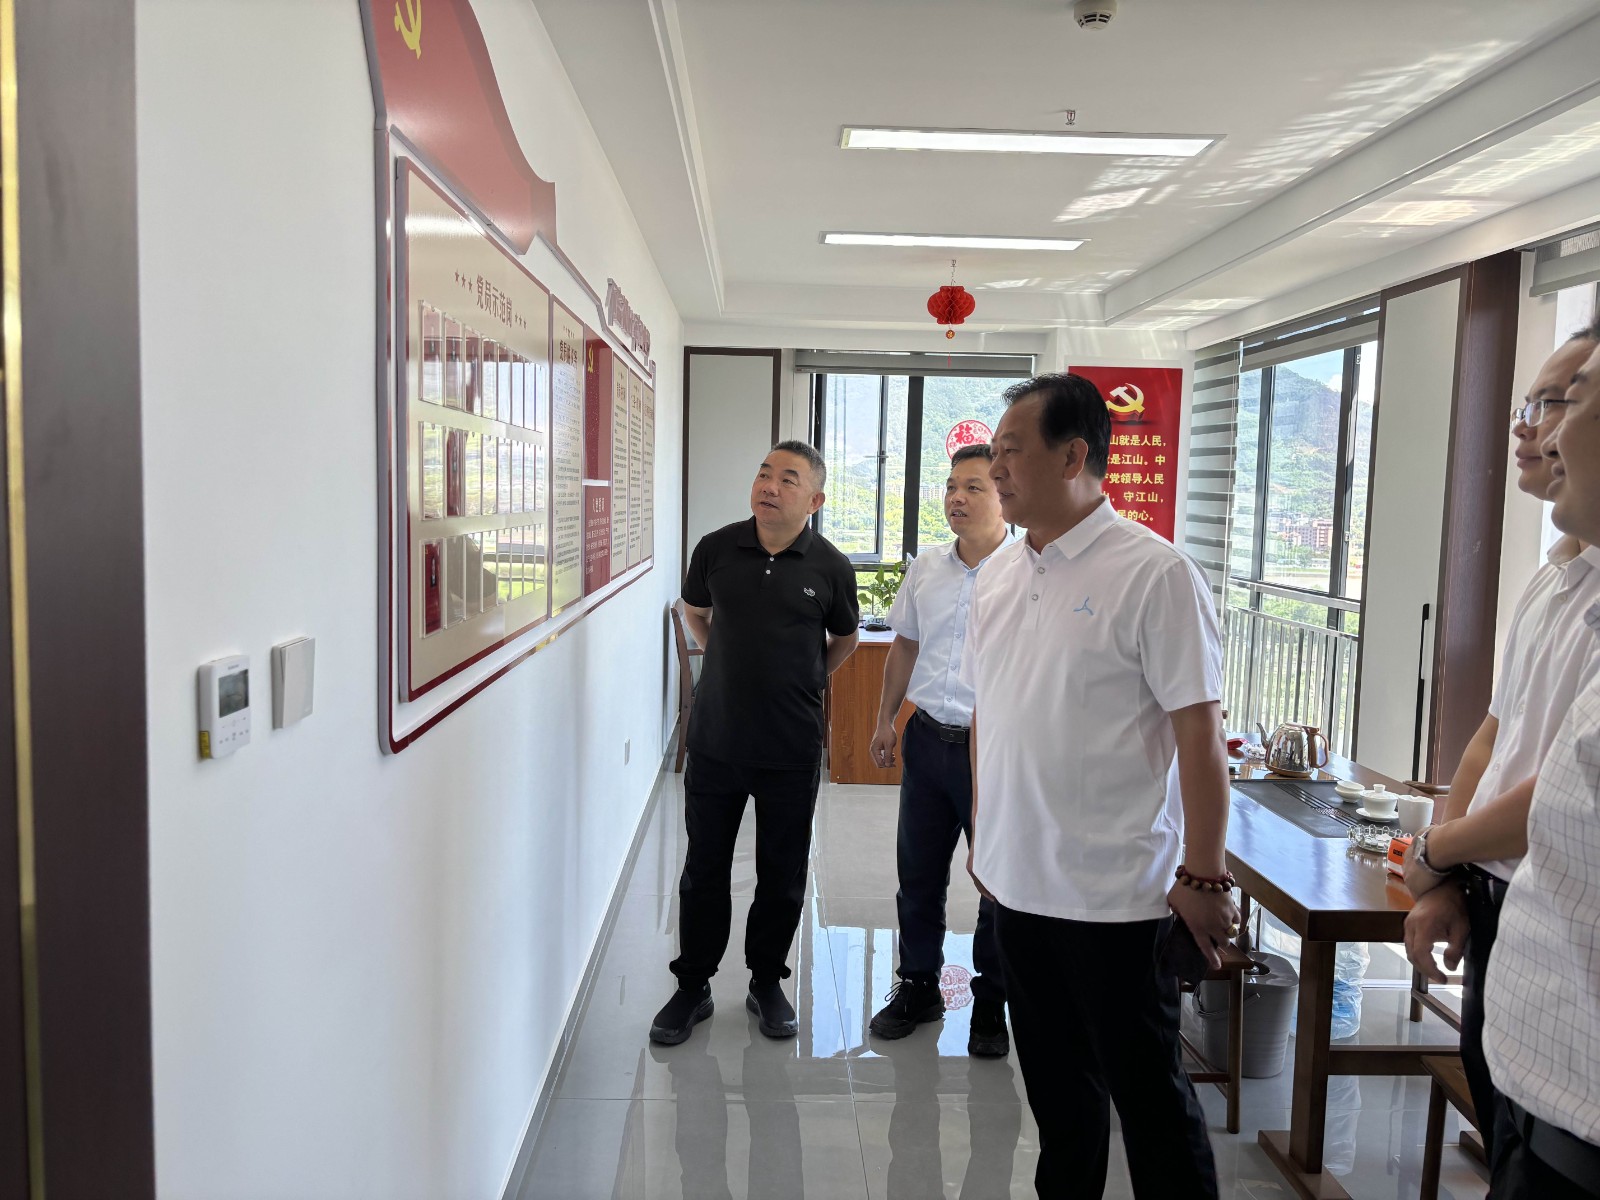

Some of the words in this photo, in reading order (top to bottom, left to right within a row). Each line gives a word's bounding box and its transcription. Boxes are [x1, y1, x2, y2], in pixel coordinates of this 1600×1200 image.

[477, 274, 512, 328] 党员示范岗
[1110, 435, 1166, 447] 山就是人民，
